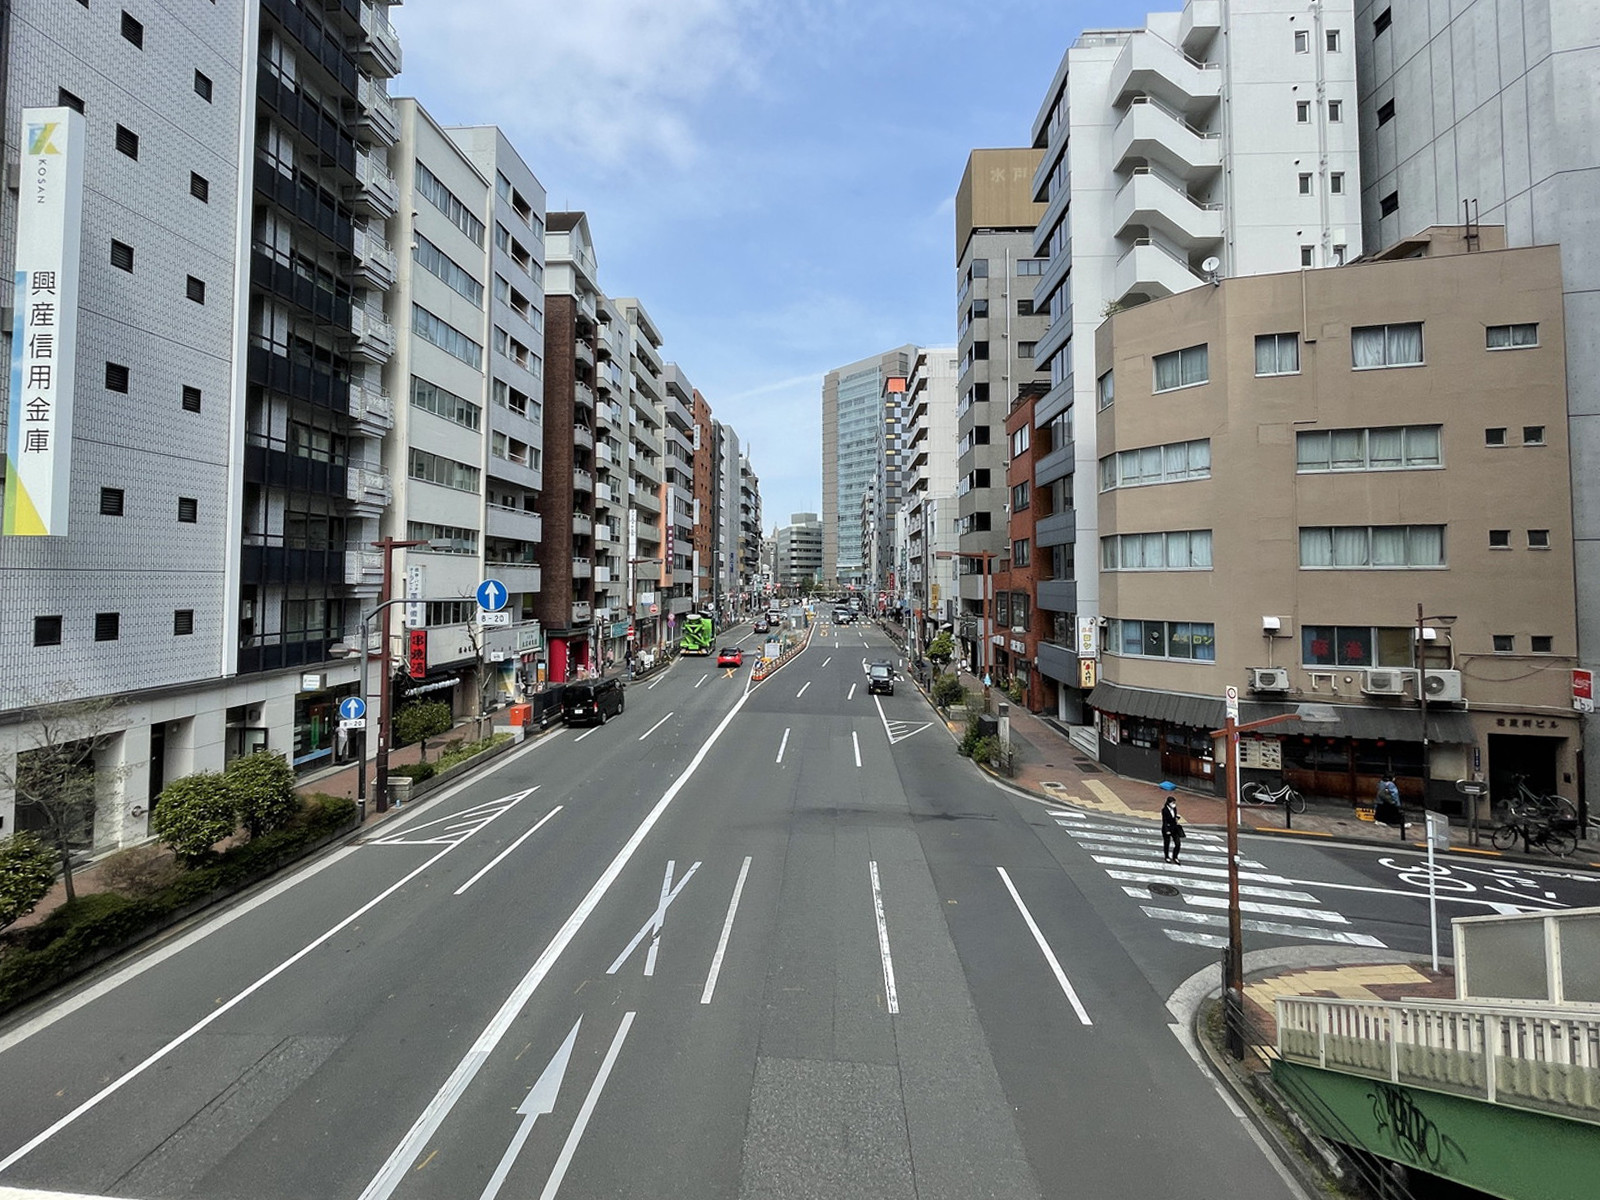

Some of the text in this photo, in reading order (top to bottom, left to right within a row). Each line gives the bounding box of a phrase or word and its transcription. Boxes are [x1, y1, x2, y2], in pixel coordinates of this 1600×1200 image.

[37, 159, 47, 204] KOSAN
[24, 271, 56, 453] 興産信用金庫
[481, 615, 505, 623] 8-20
[1378, 858, 1477, 892] 30
